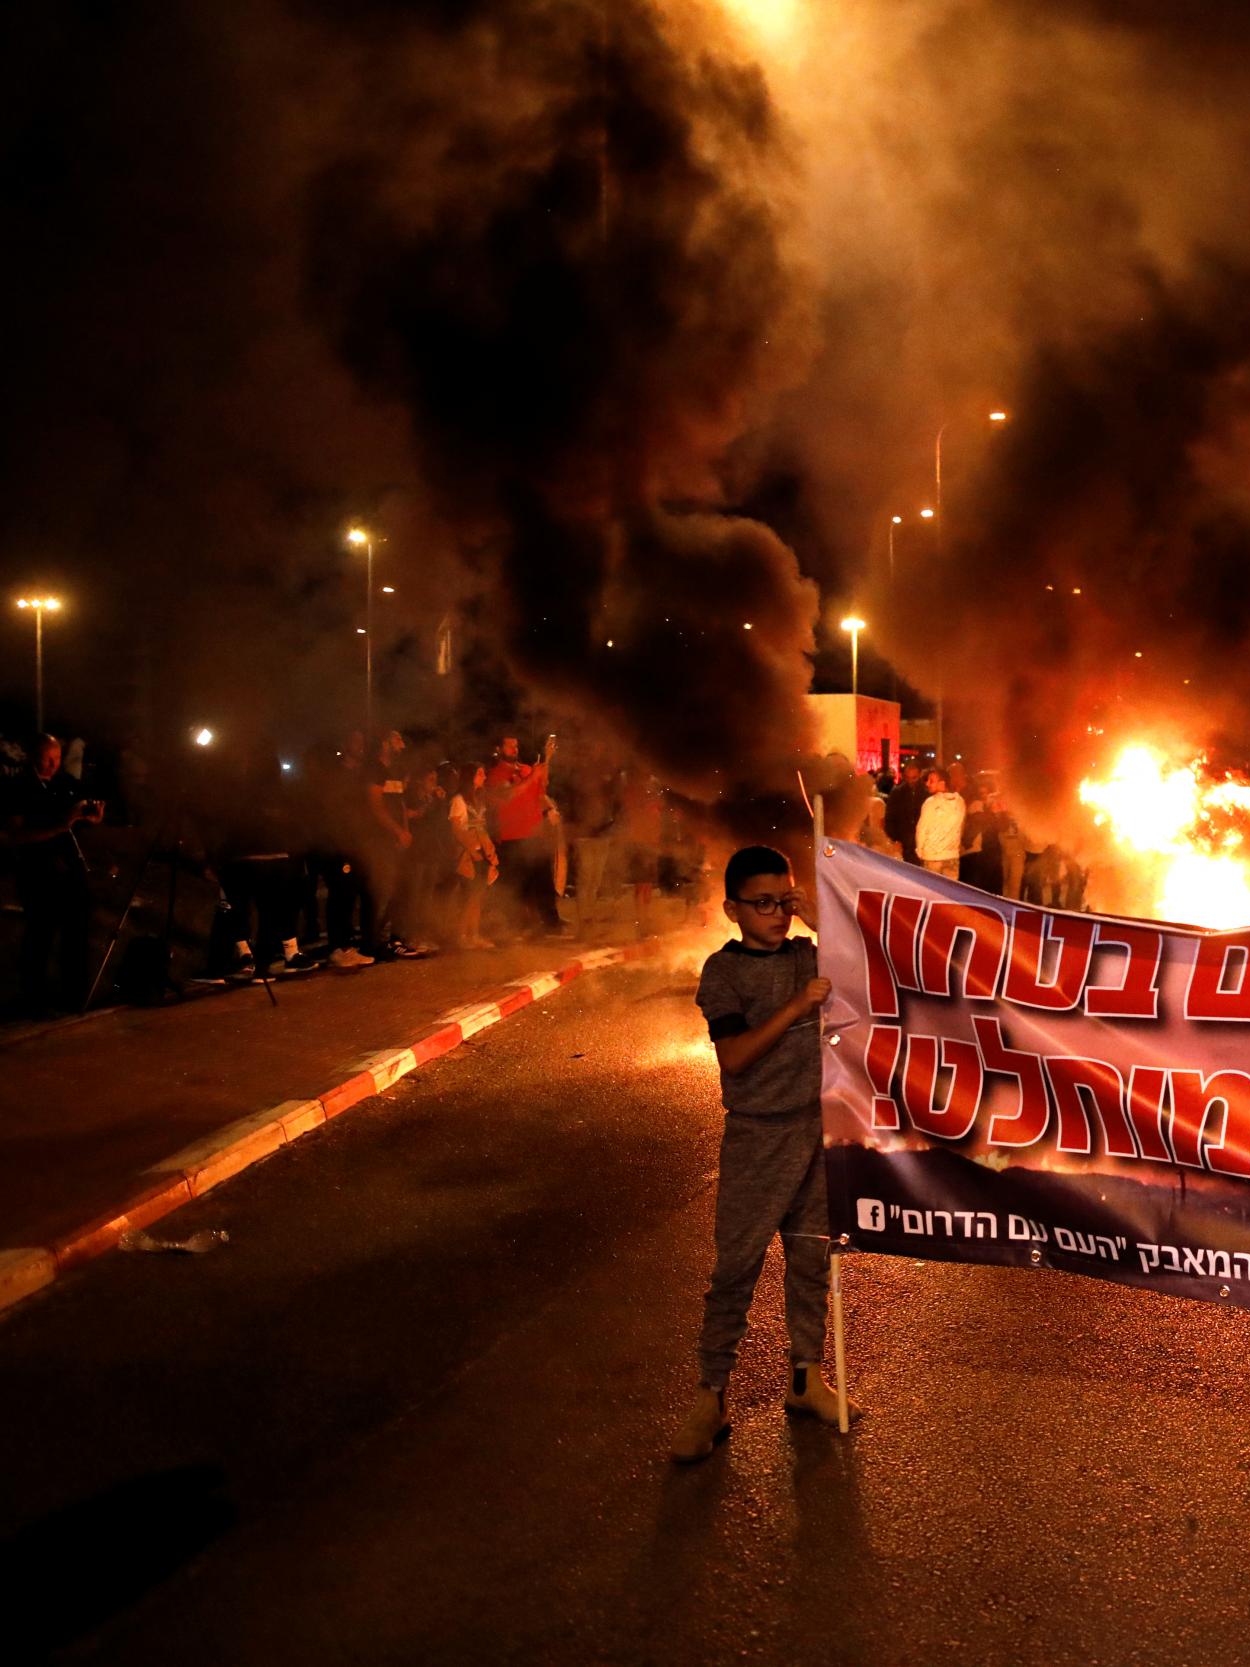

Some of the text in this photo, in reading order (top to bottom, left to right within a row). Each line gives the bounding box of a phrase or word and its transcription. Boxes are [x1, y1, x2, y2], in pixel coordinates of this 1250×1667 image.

[856, 889, 1163, 1018] בטחון
[890, 1204, 998, 1239] הדרום"
[1008, 1214, 1048, 1242] עם
[1054, 1227, 1127, 1261] "העם
